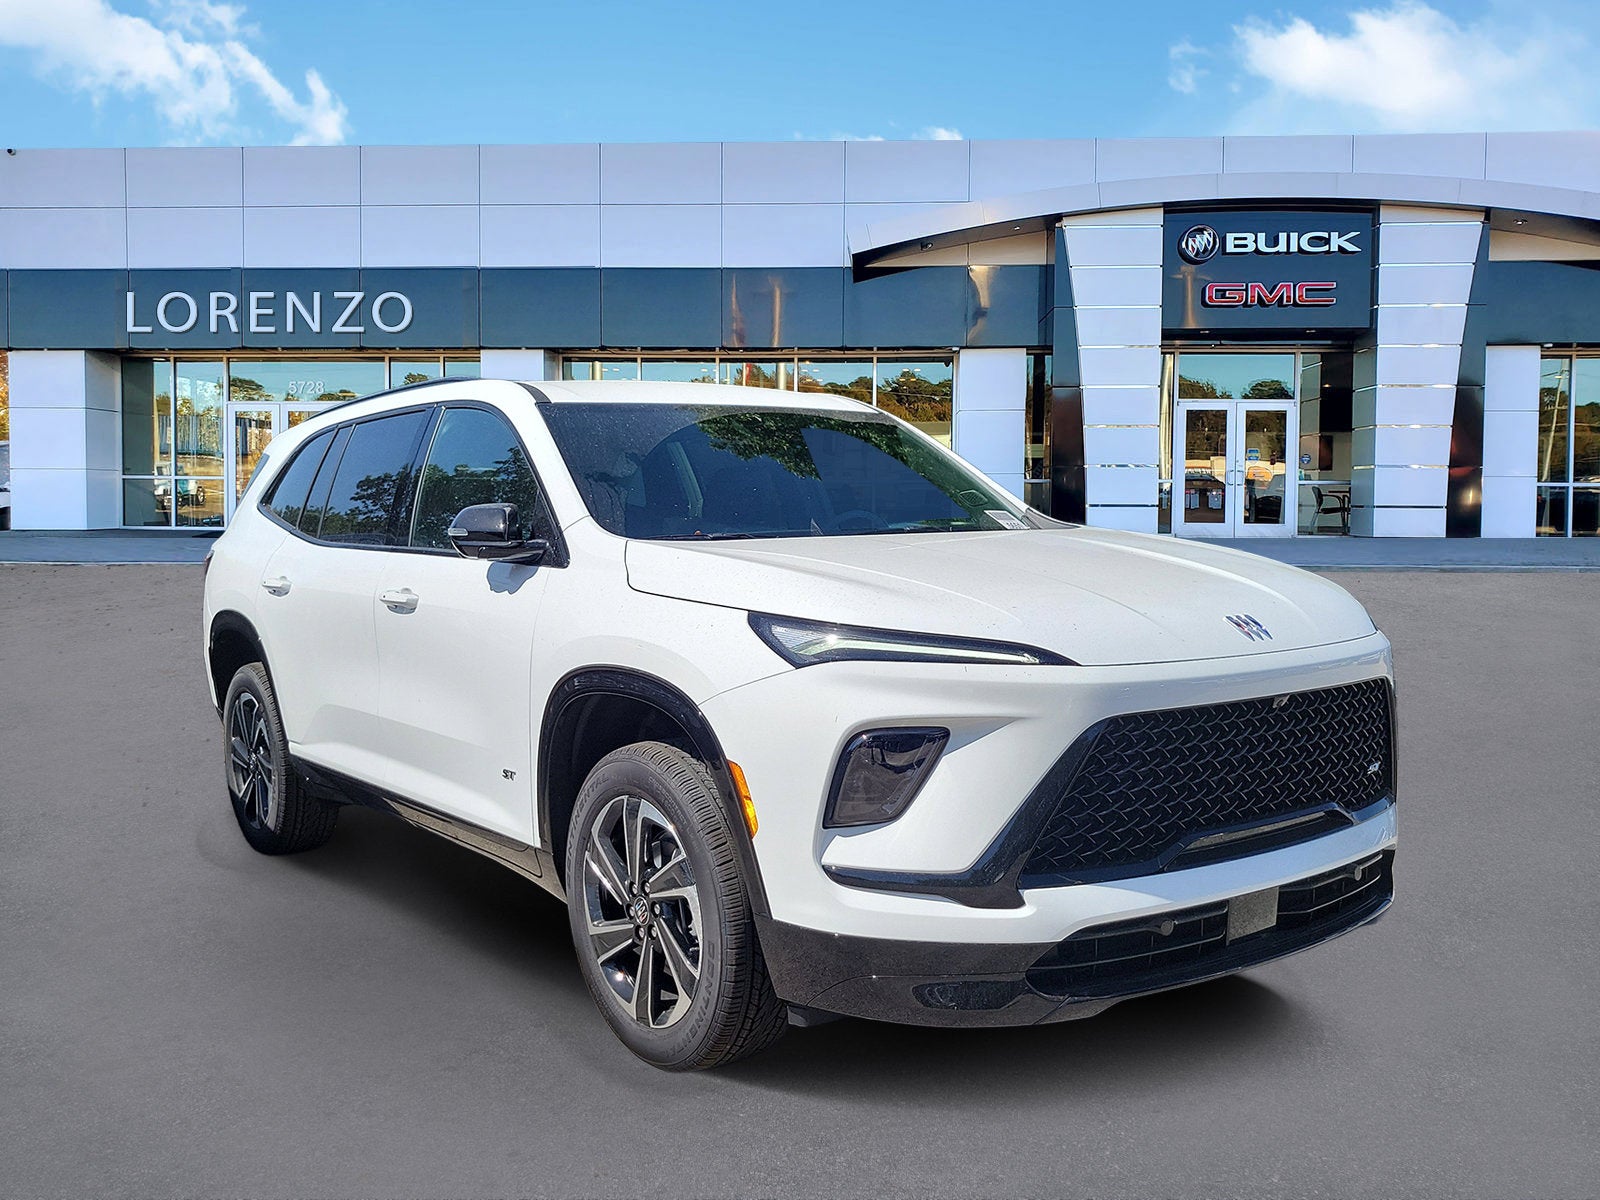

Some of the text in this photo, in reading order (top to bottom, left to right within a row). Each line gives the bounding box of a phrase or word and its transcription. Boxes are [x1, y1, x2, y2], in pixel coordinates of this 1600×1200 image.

[1226, 231, 1361, 253] BUICK
[1204, 281, 1337, 307] GMC
[126, 290, 414, 334] LORENZO
[288, 381, 325, 394] 5728
[502, 768, 517, 781] ST
